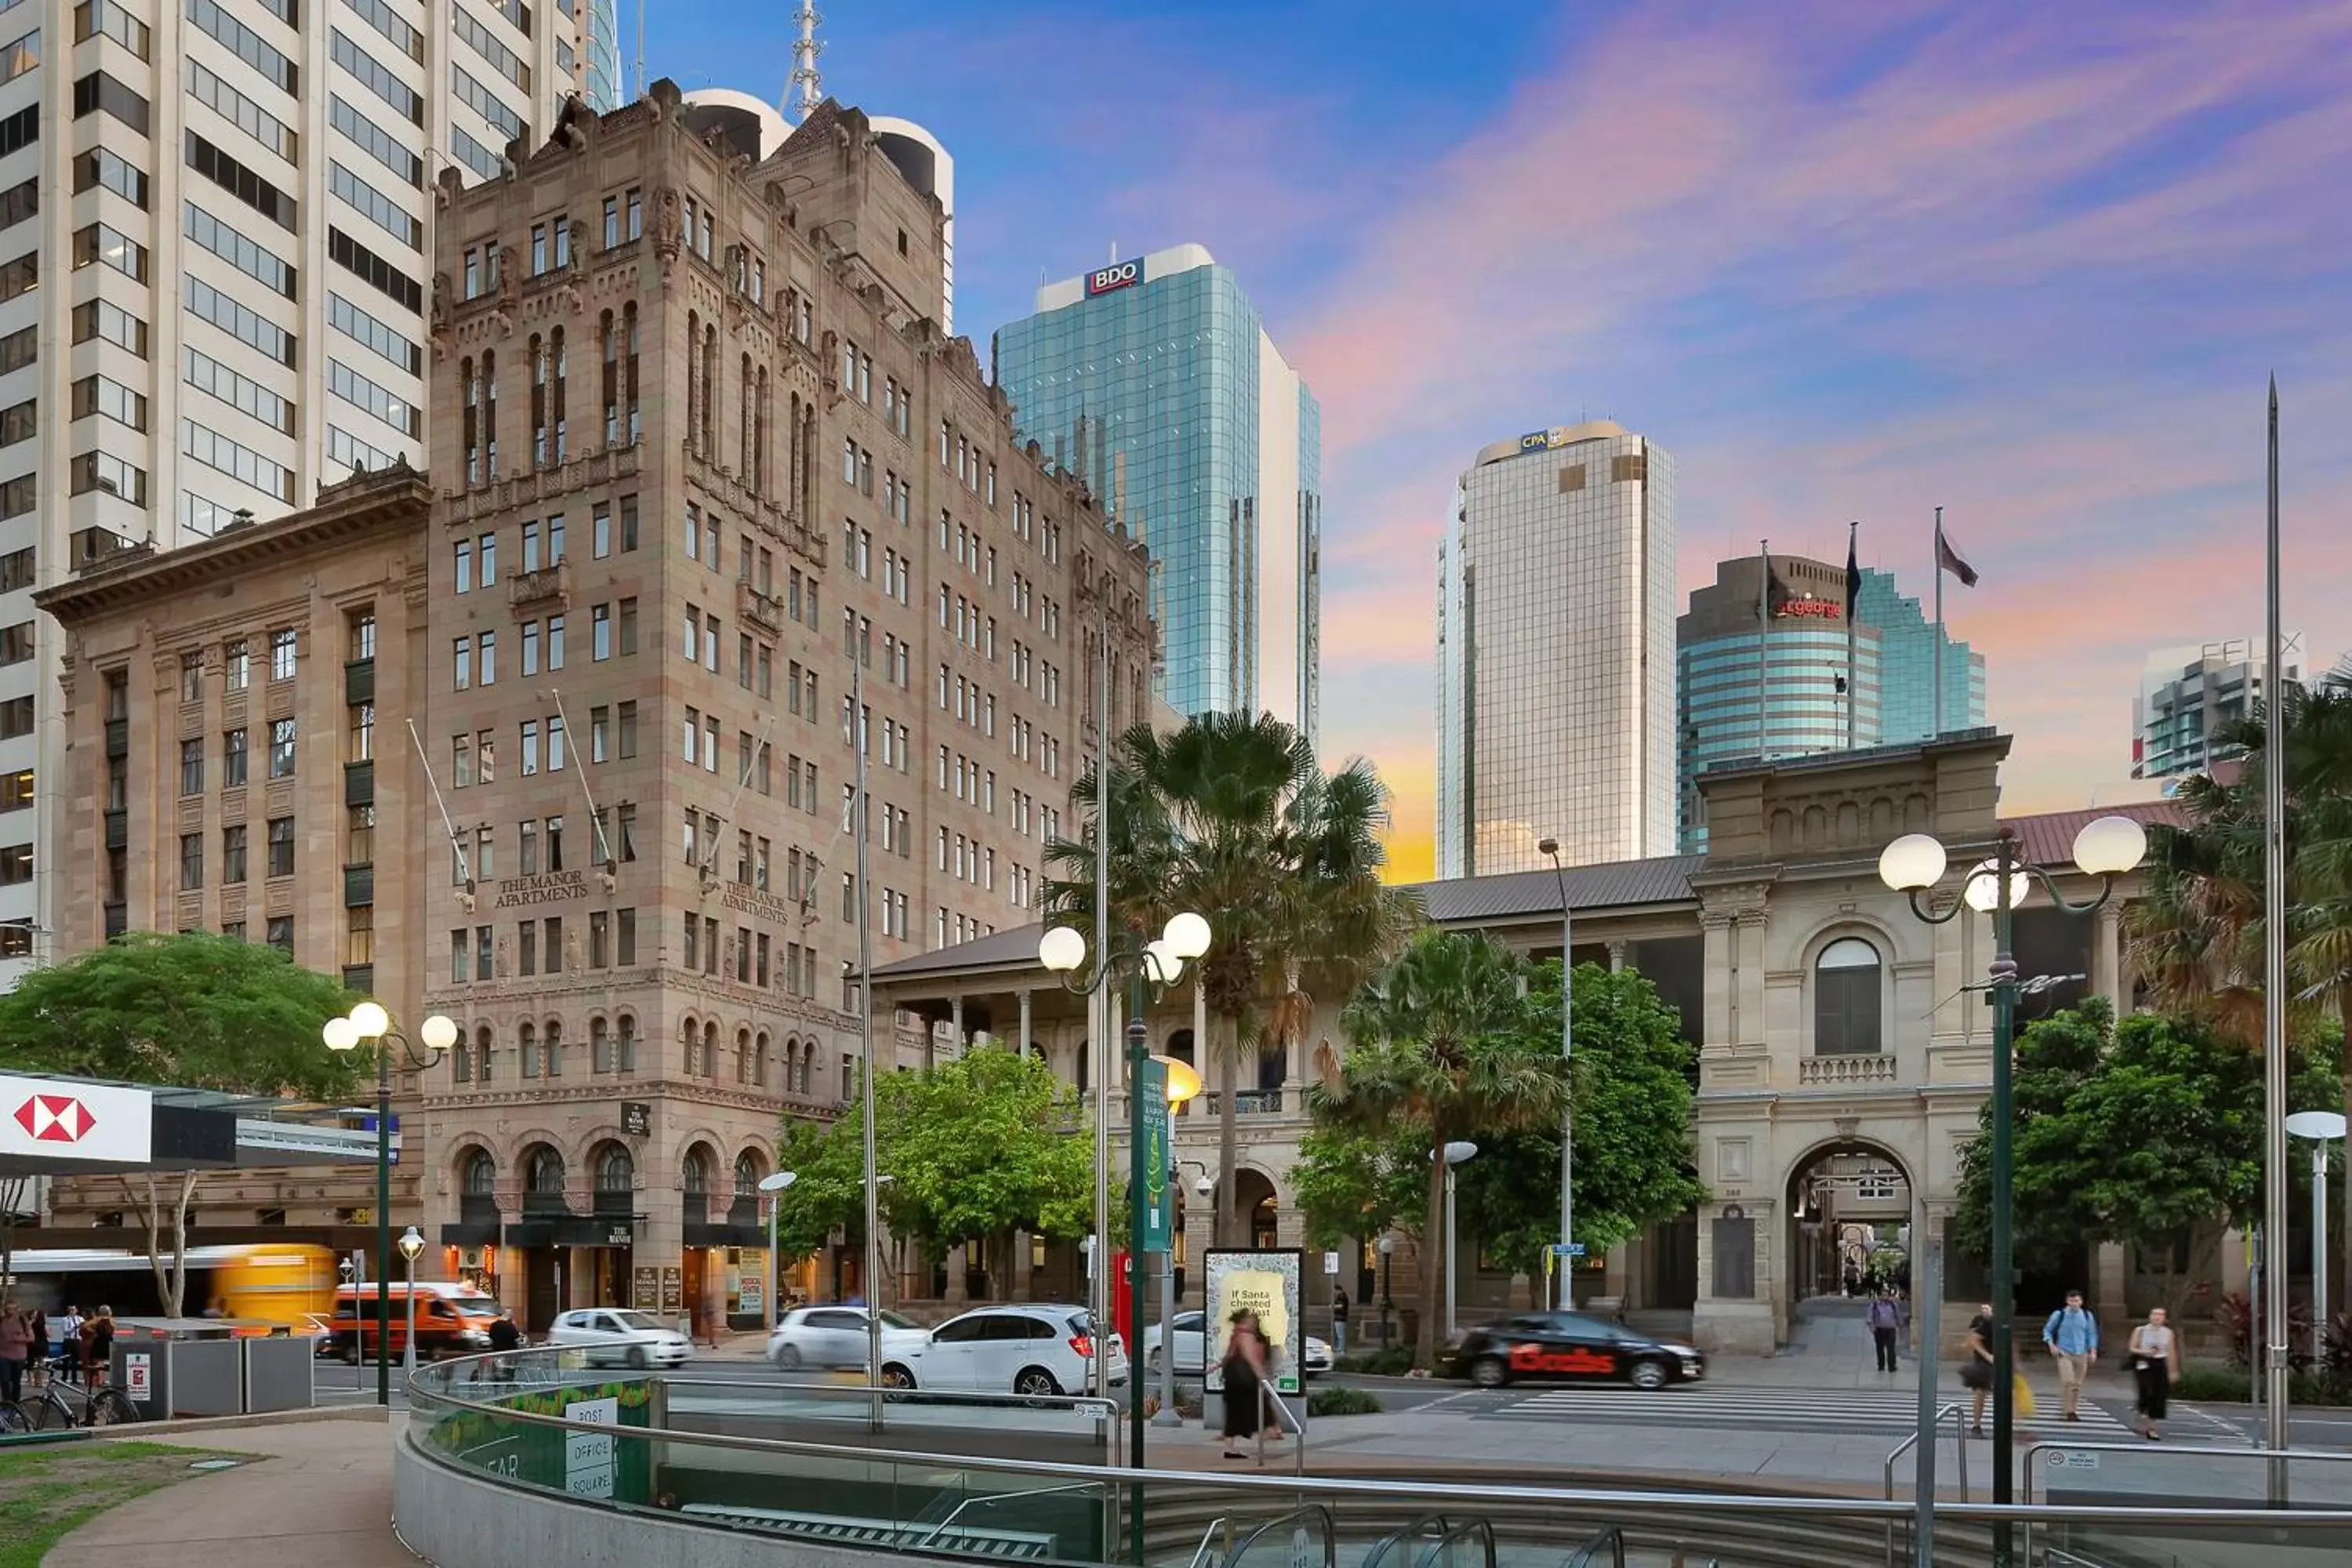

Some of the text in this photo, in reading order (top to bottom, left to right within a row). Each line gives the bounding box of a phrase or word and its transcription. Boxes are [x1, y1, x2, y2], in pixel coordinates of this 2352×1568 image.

[1096, 263, 1136, 288] BDO
[2201, 631, 2302, 663] FELX
[499, 869, 583, 893] THE MANOR
[726, 880, 748, 898] THE
[495, 884, 589, 909] APARTMENTS
[1230, 1298, 1271, 1308] cheated
[1241, 1290, 1270, 1299] Santa
[579, 1409, 603, 1424] POST
[575, 1441, 610, 1461] OFFICE
